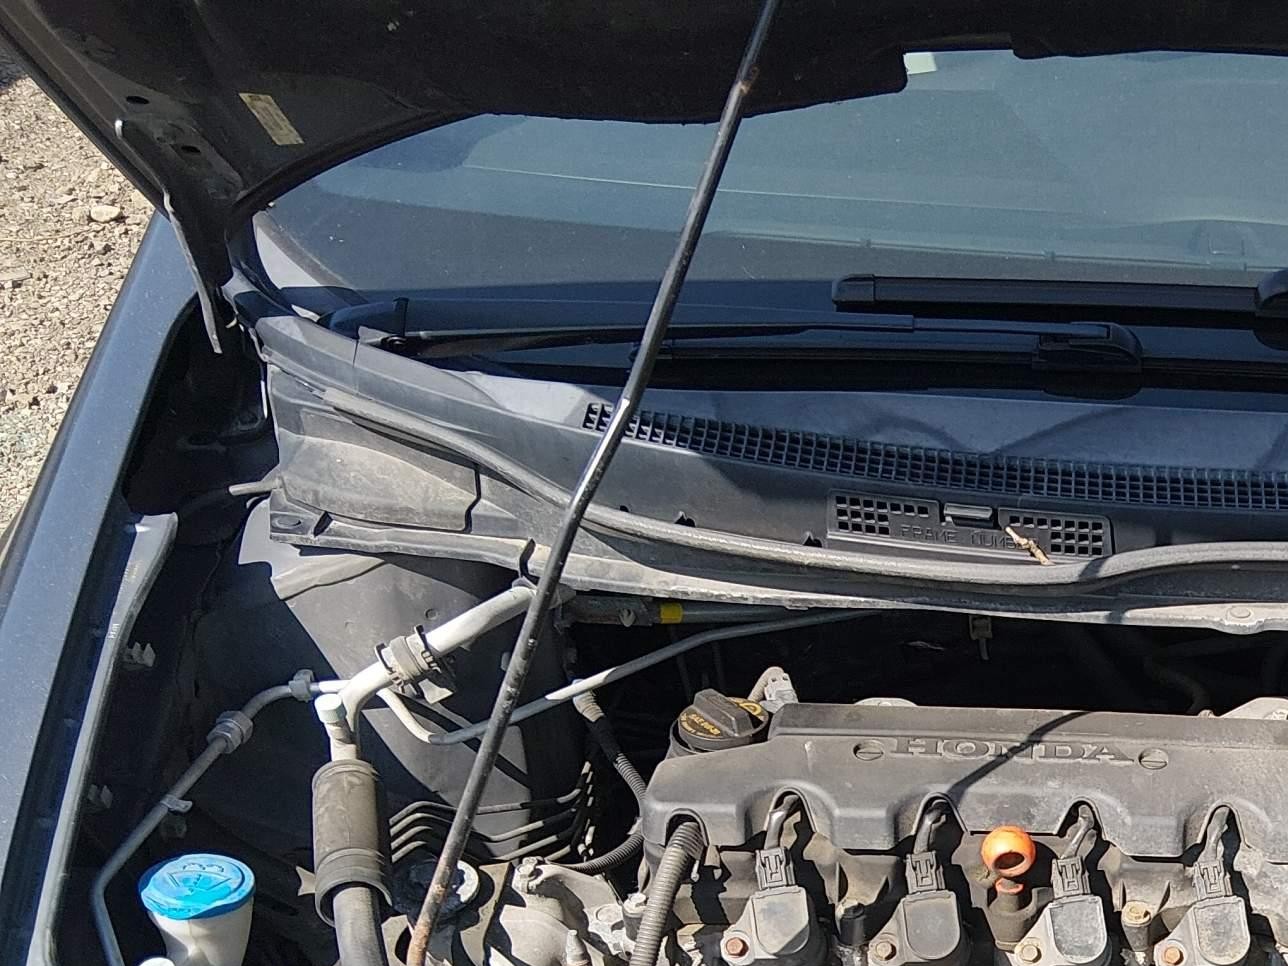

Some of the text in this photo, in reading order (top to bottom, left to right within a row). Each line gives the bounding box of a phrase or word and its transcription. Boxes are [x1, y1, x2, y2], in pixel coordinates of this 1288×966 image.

[901, 525, 1039, 549] FRAME NUMB
[892, 739, 1134, 763] HONDA
